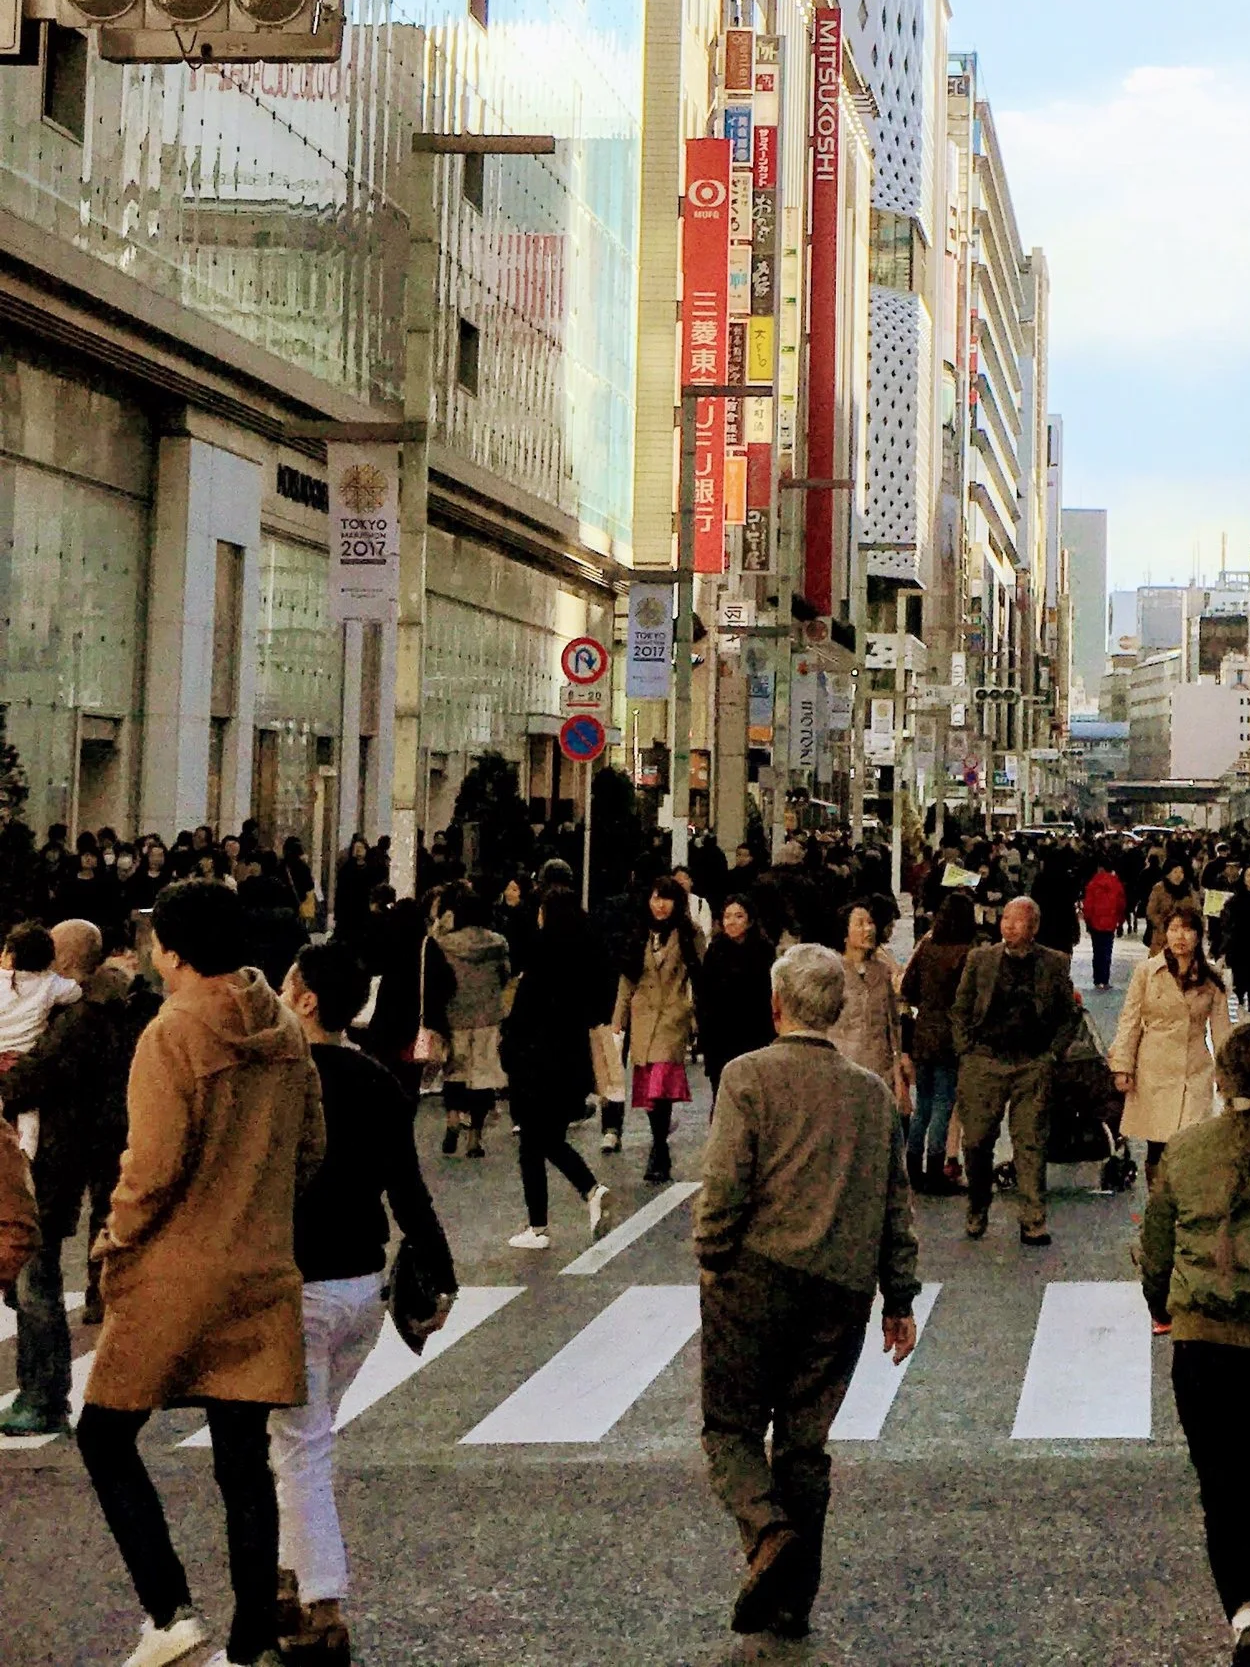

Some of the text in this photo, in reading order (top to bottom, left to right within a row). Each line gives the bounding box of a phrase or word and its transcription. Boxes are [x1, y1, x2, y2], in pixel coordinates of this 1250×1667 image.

[816, 19, 838, 182] MITSUKOSHI
[340, 518, 388, 530] TOKYO
[341, 541, 387, 557] 2017
[634, 646, 665, 657] 2017
